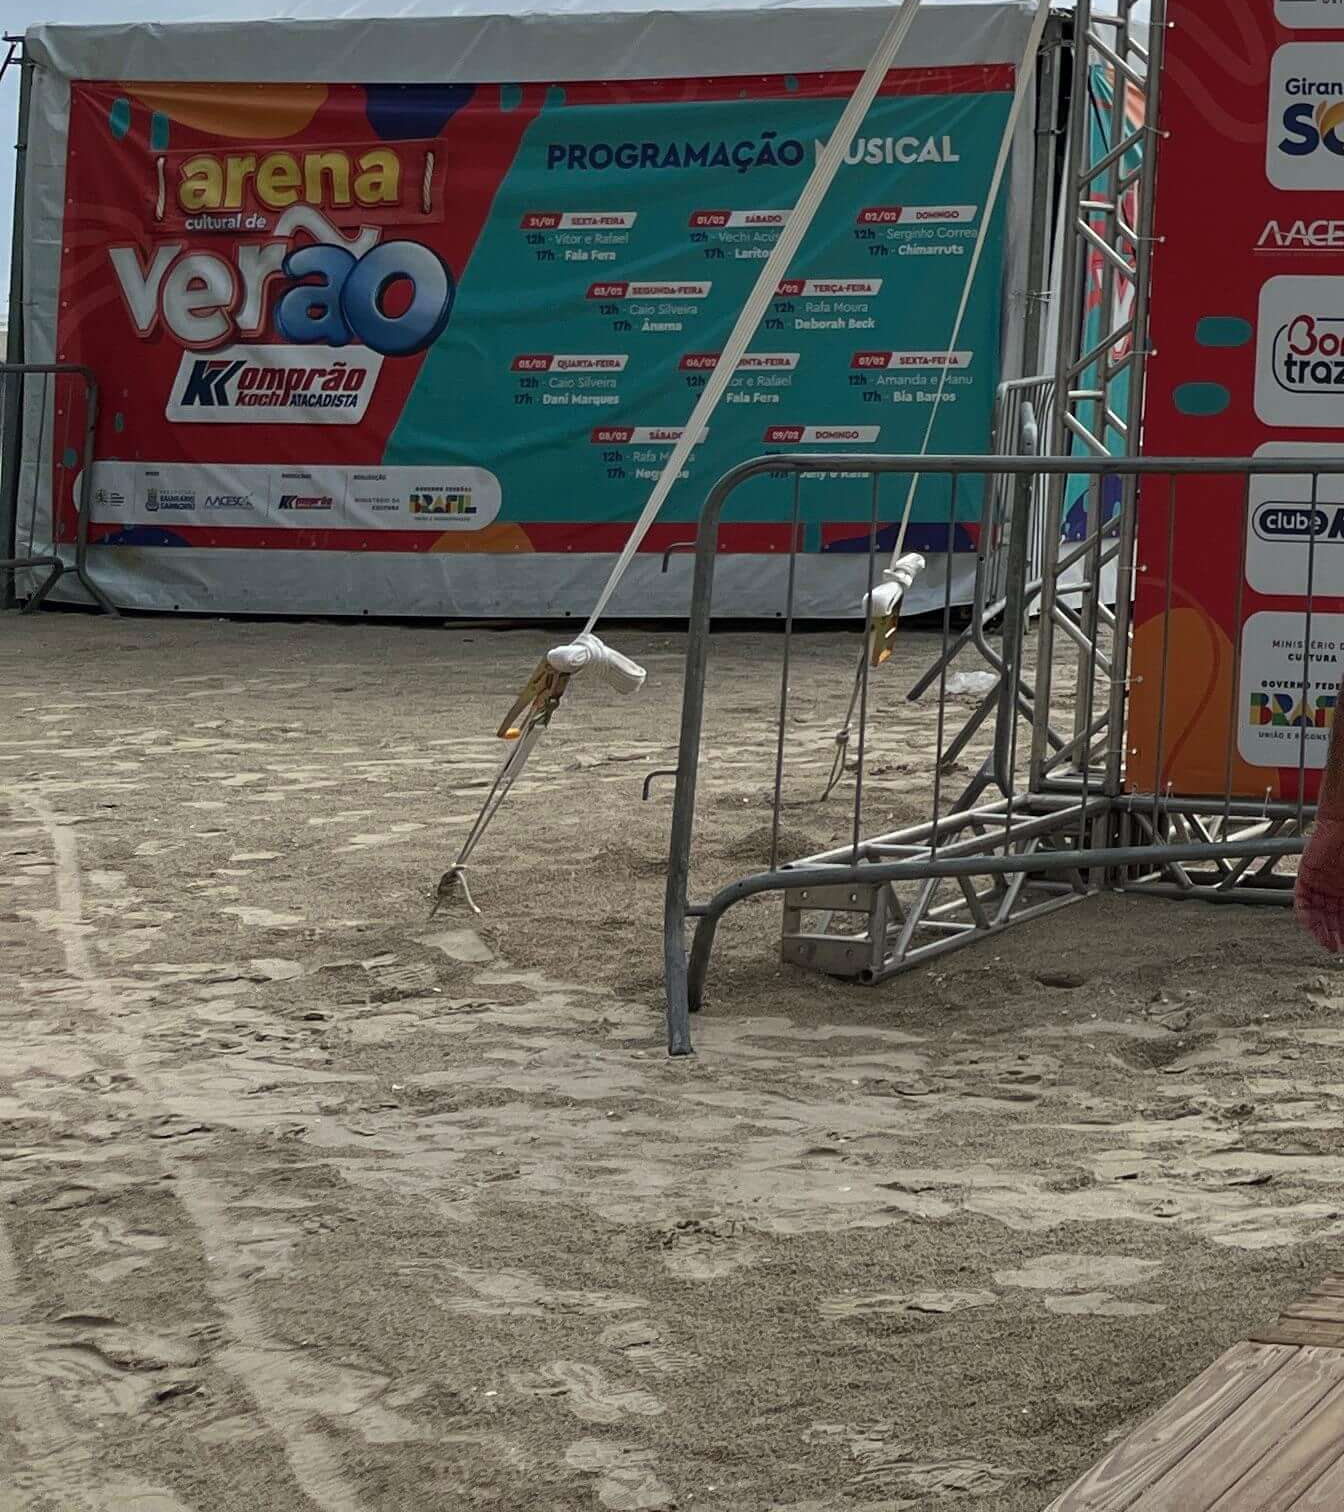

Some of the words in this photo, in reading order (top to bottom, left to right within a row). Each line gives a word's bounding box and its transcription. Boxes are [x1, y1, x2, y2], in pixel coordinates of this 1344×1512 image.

[547, 131, 804, 173] PROGRAMAÇÃO
[178, 149, 401, 212] arena
[185, 213, 242, 230] cultural
[245, 212, 266, 228] de
[571, 217, 625, 225] SEXTA-FEIRA
[697, 216, 725, 224] 01/02
[745, 215, 782, 223] SÁBADO
[864, 212, 896, 221] 02/02
[916, 210, 960, 219] DOMINGO
[526, 233, 545, 244] 12h
[690, 232, 708, 242] 12h
[854, 229, 875, 239] 12h
[886, 228, 934, 241] Serginho
[536, 249, 555, 261] 17h
[704, 248, 725, 259] 17h
[868, 245, 888, 256] 17h
[898, 244, 965, 256] Chimarruts
[108, 206, 455, 356] verão
[631, 287, 704, 295] SEGUNDA-FEIRA
[813, 284, 872, 294] TERÇA-FEIRA
[600, 304, 619, 315] 12h
[774, 302, 795, 313] 12h
[834, 302, 869, 313] Moura
[613, 320, 632, 331] 17h
[765, 317, 784, 329] 17h
[794, 317, 845, 329] Deborah
[847, 317, 876, 329] Beck
[557, 359, 621, 369] QUARTA-FEIRA
[900, 356, 959, 365] SEXTA-FERA
[520, 377, 539, 388] 12h
[757, 375, 792, 386] Rafael
[849, 373, 867, 385] 12h
[876, 374, 927, 385] Amanda
[290, 393, 359, 407] ATACADISTA
[514, 393, 533, 404] 17h
[571, 393, 620, 406] Marques
[753, 392, 780, 403] Fera
[863, 391, 882, 403] 17h
[893, 390, 913, 402] Bia
[916, 391, 957, 403] Baros
[816, 431, 859, 439] DOMINGO
[602, 451, 623, 462] 12h
[607, 467, 625, 479] 17h
[1266, 511, 1322, 531] clube
[1272, 639, 1336, 650] MINISÉRIO
[1315, 682, 1342, 691] FEDE
